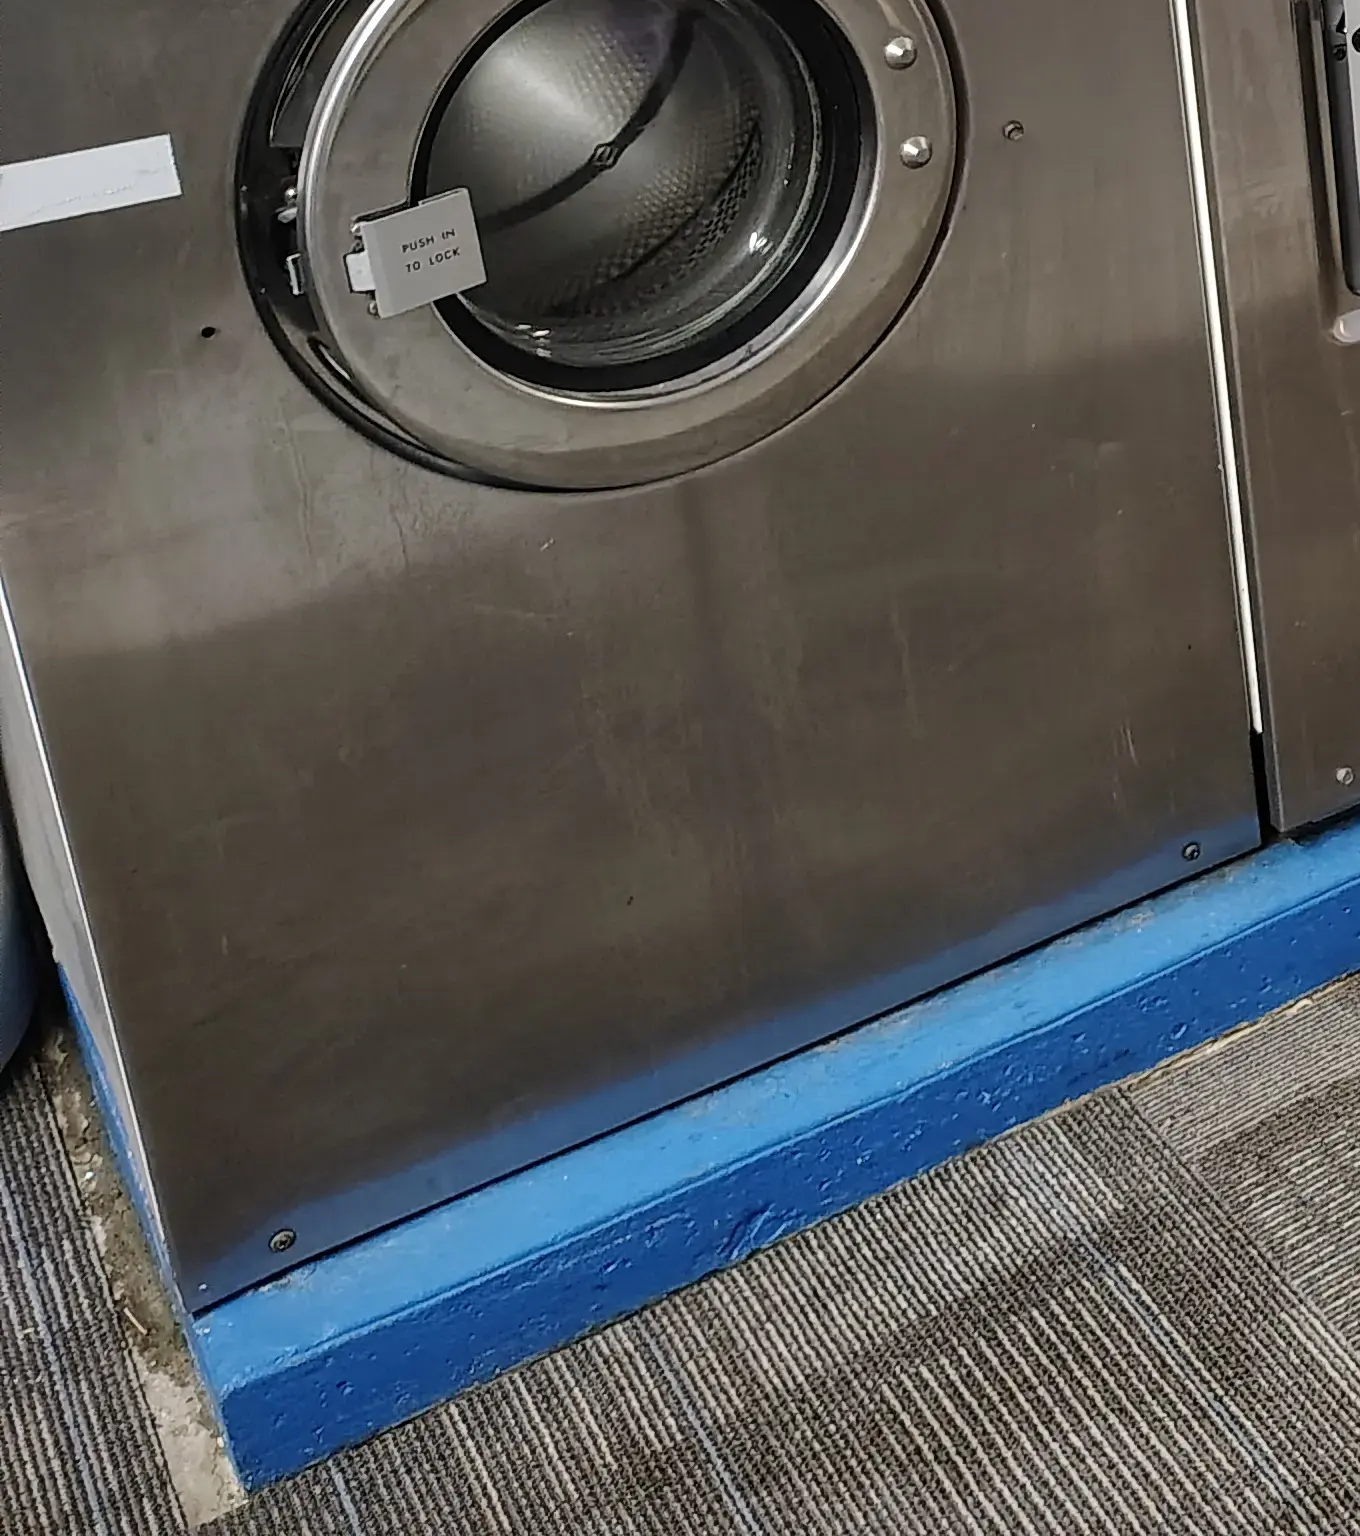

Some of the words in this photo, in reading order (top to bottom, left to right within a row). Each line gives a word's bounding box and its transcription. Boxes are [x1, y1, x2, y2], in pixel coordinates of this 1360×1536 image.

[401, 235, 435, 254] PUSH
[441, 228, 456, 241] IN
[405, 260, 421, 273] TO
[428, 246, 461, 266] LOCK
